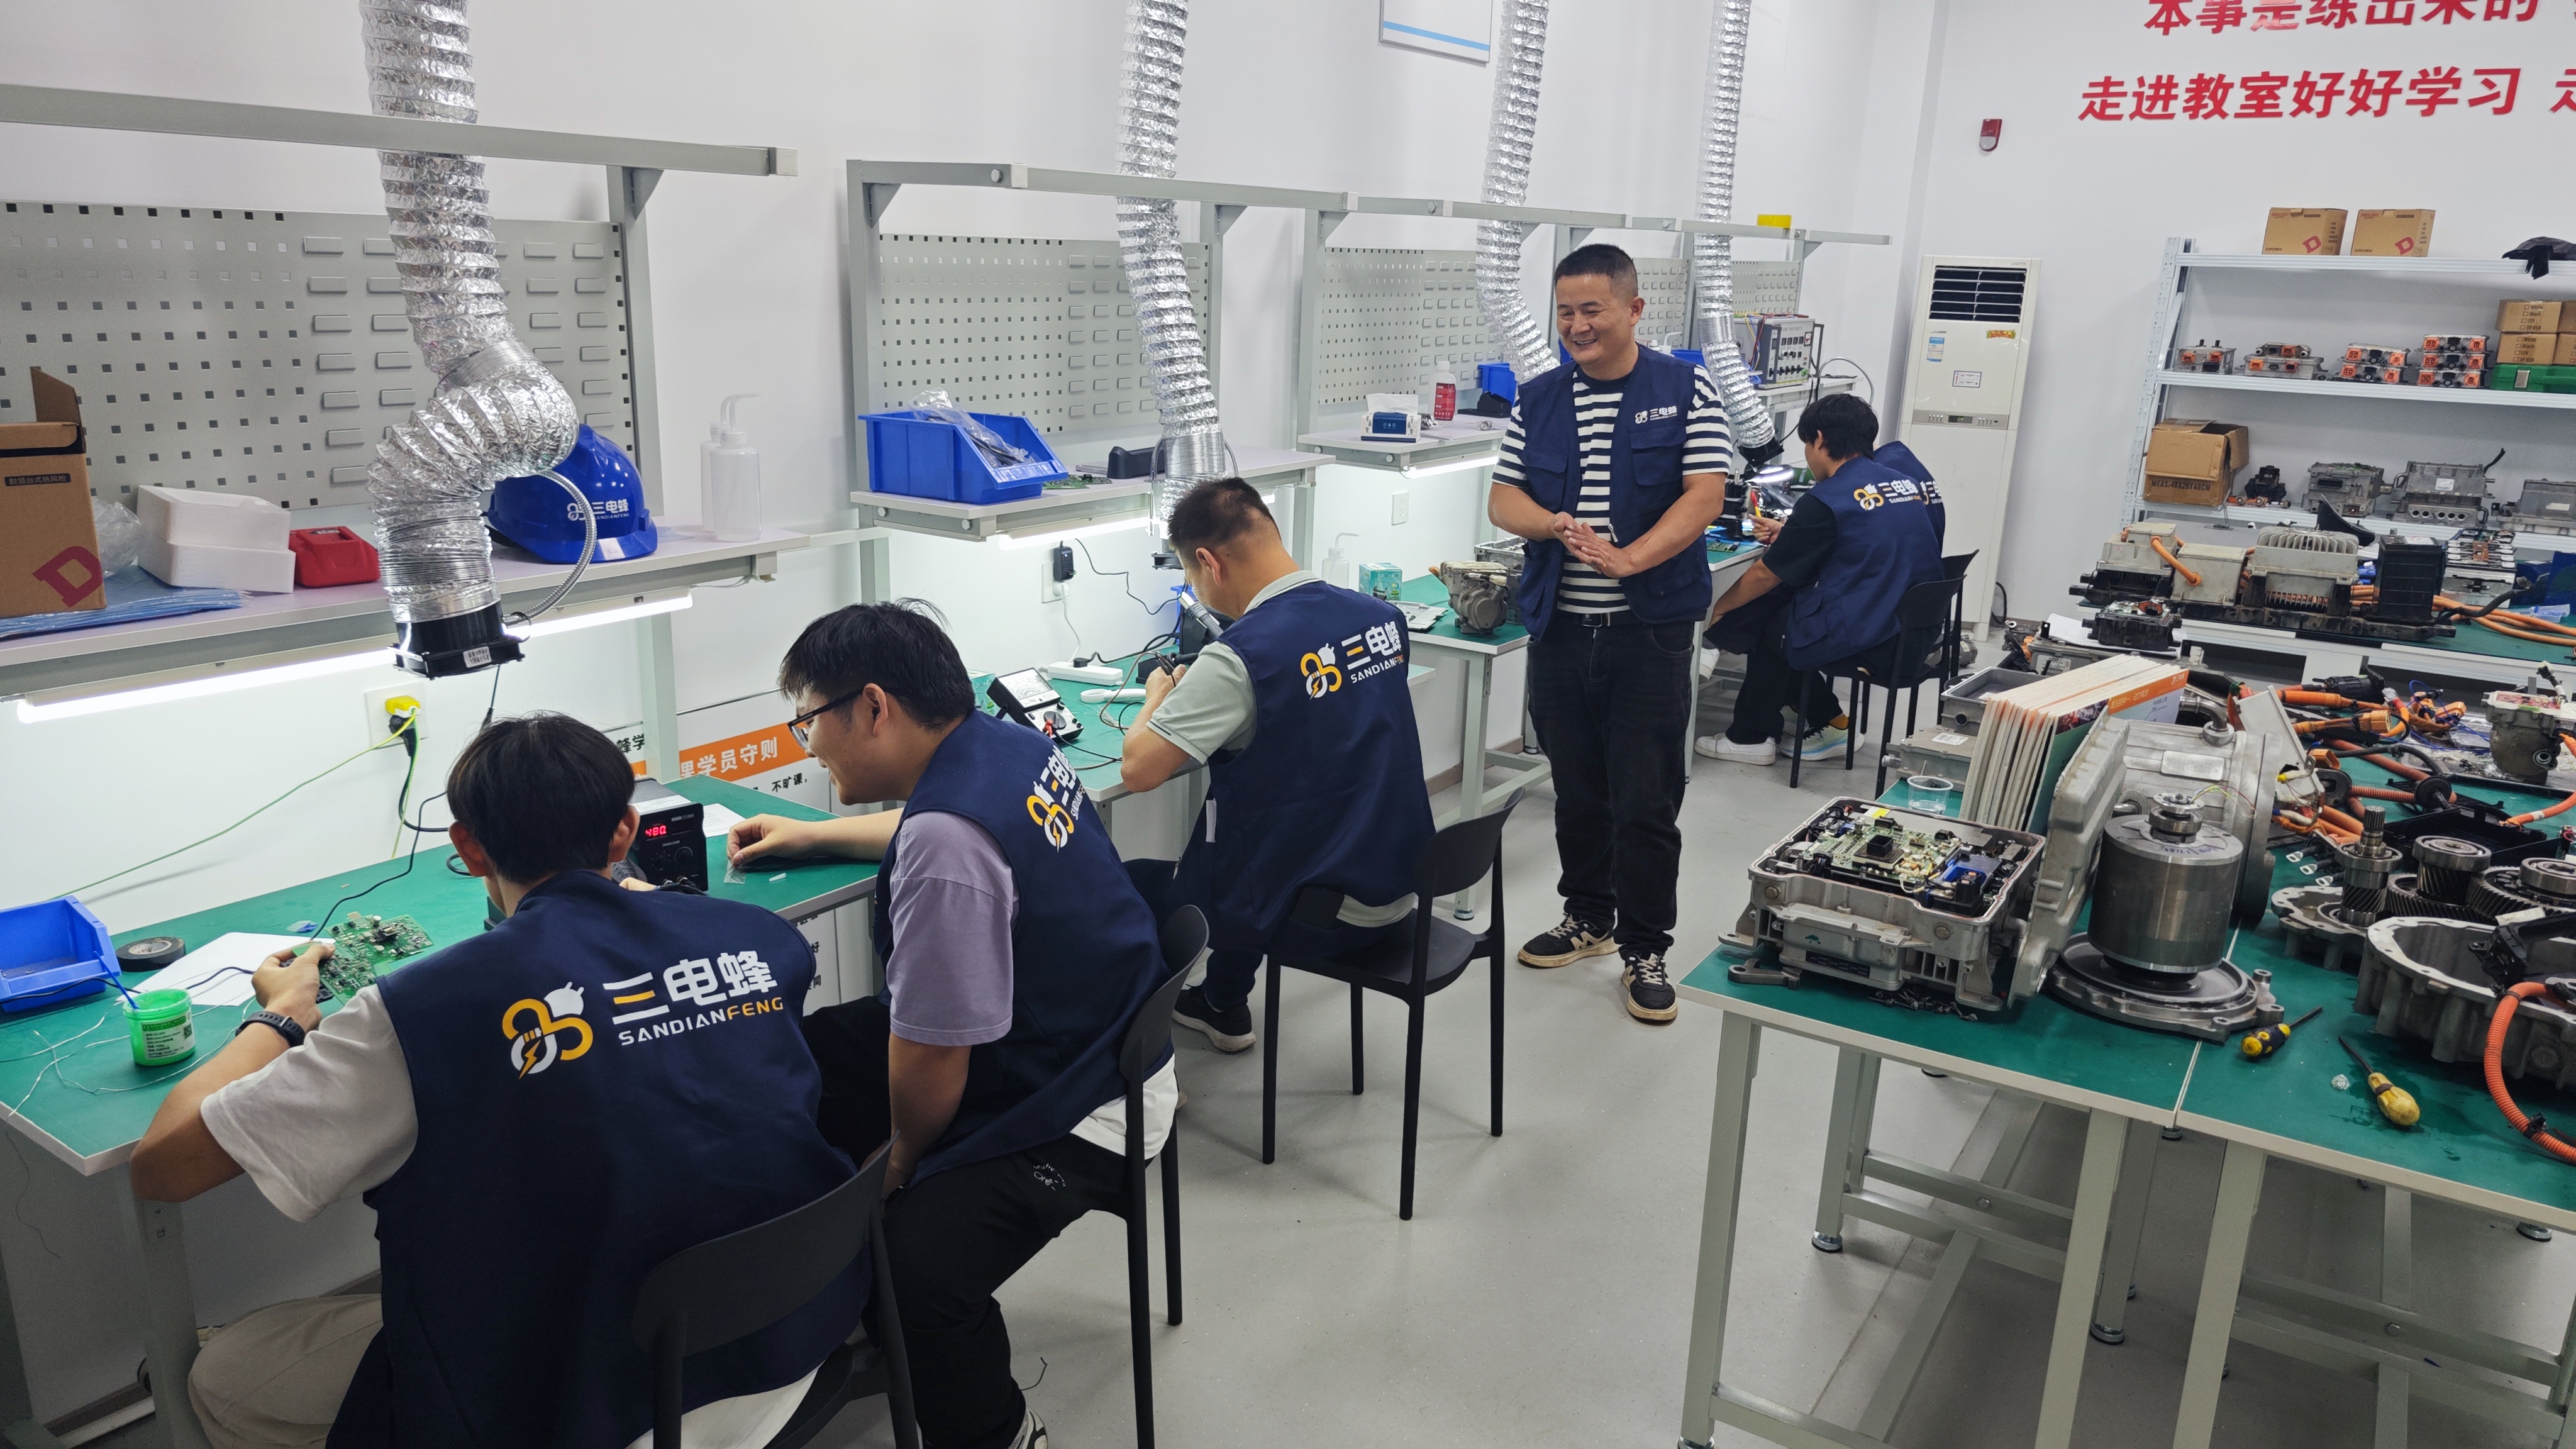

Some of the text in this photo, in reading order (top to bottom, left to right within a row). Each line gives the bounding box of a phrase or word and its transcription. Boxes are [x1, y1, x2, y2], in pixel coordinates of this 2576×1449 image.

[2078, 67, 2521, 121] 走进教室好好学习
[1650, 406, 1677, 418] 三电蜂
[592, 499, 629, 514] 三电蜂
[1877, 479, 1919, 497] 三电蜂
[1341, 621, 1402, 670] 三电蜂
[1041, 745, 1077, 806] 三电蜂
[645, 825, 667, 836] 480
[602, 950, 778, 1025] 三电蜂
[618, 997, 784, 1046] SANDIANFENG
